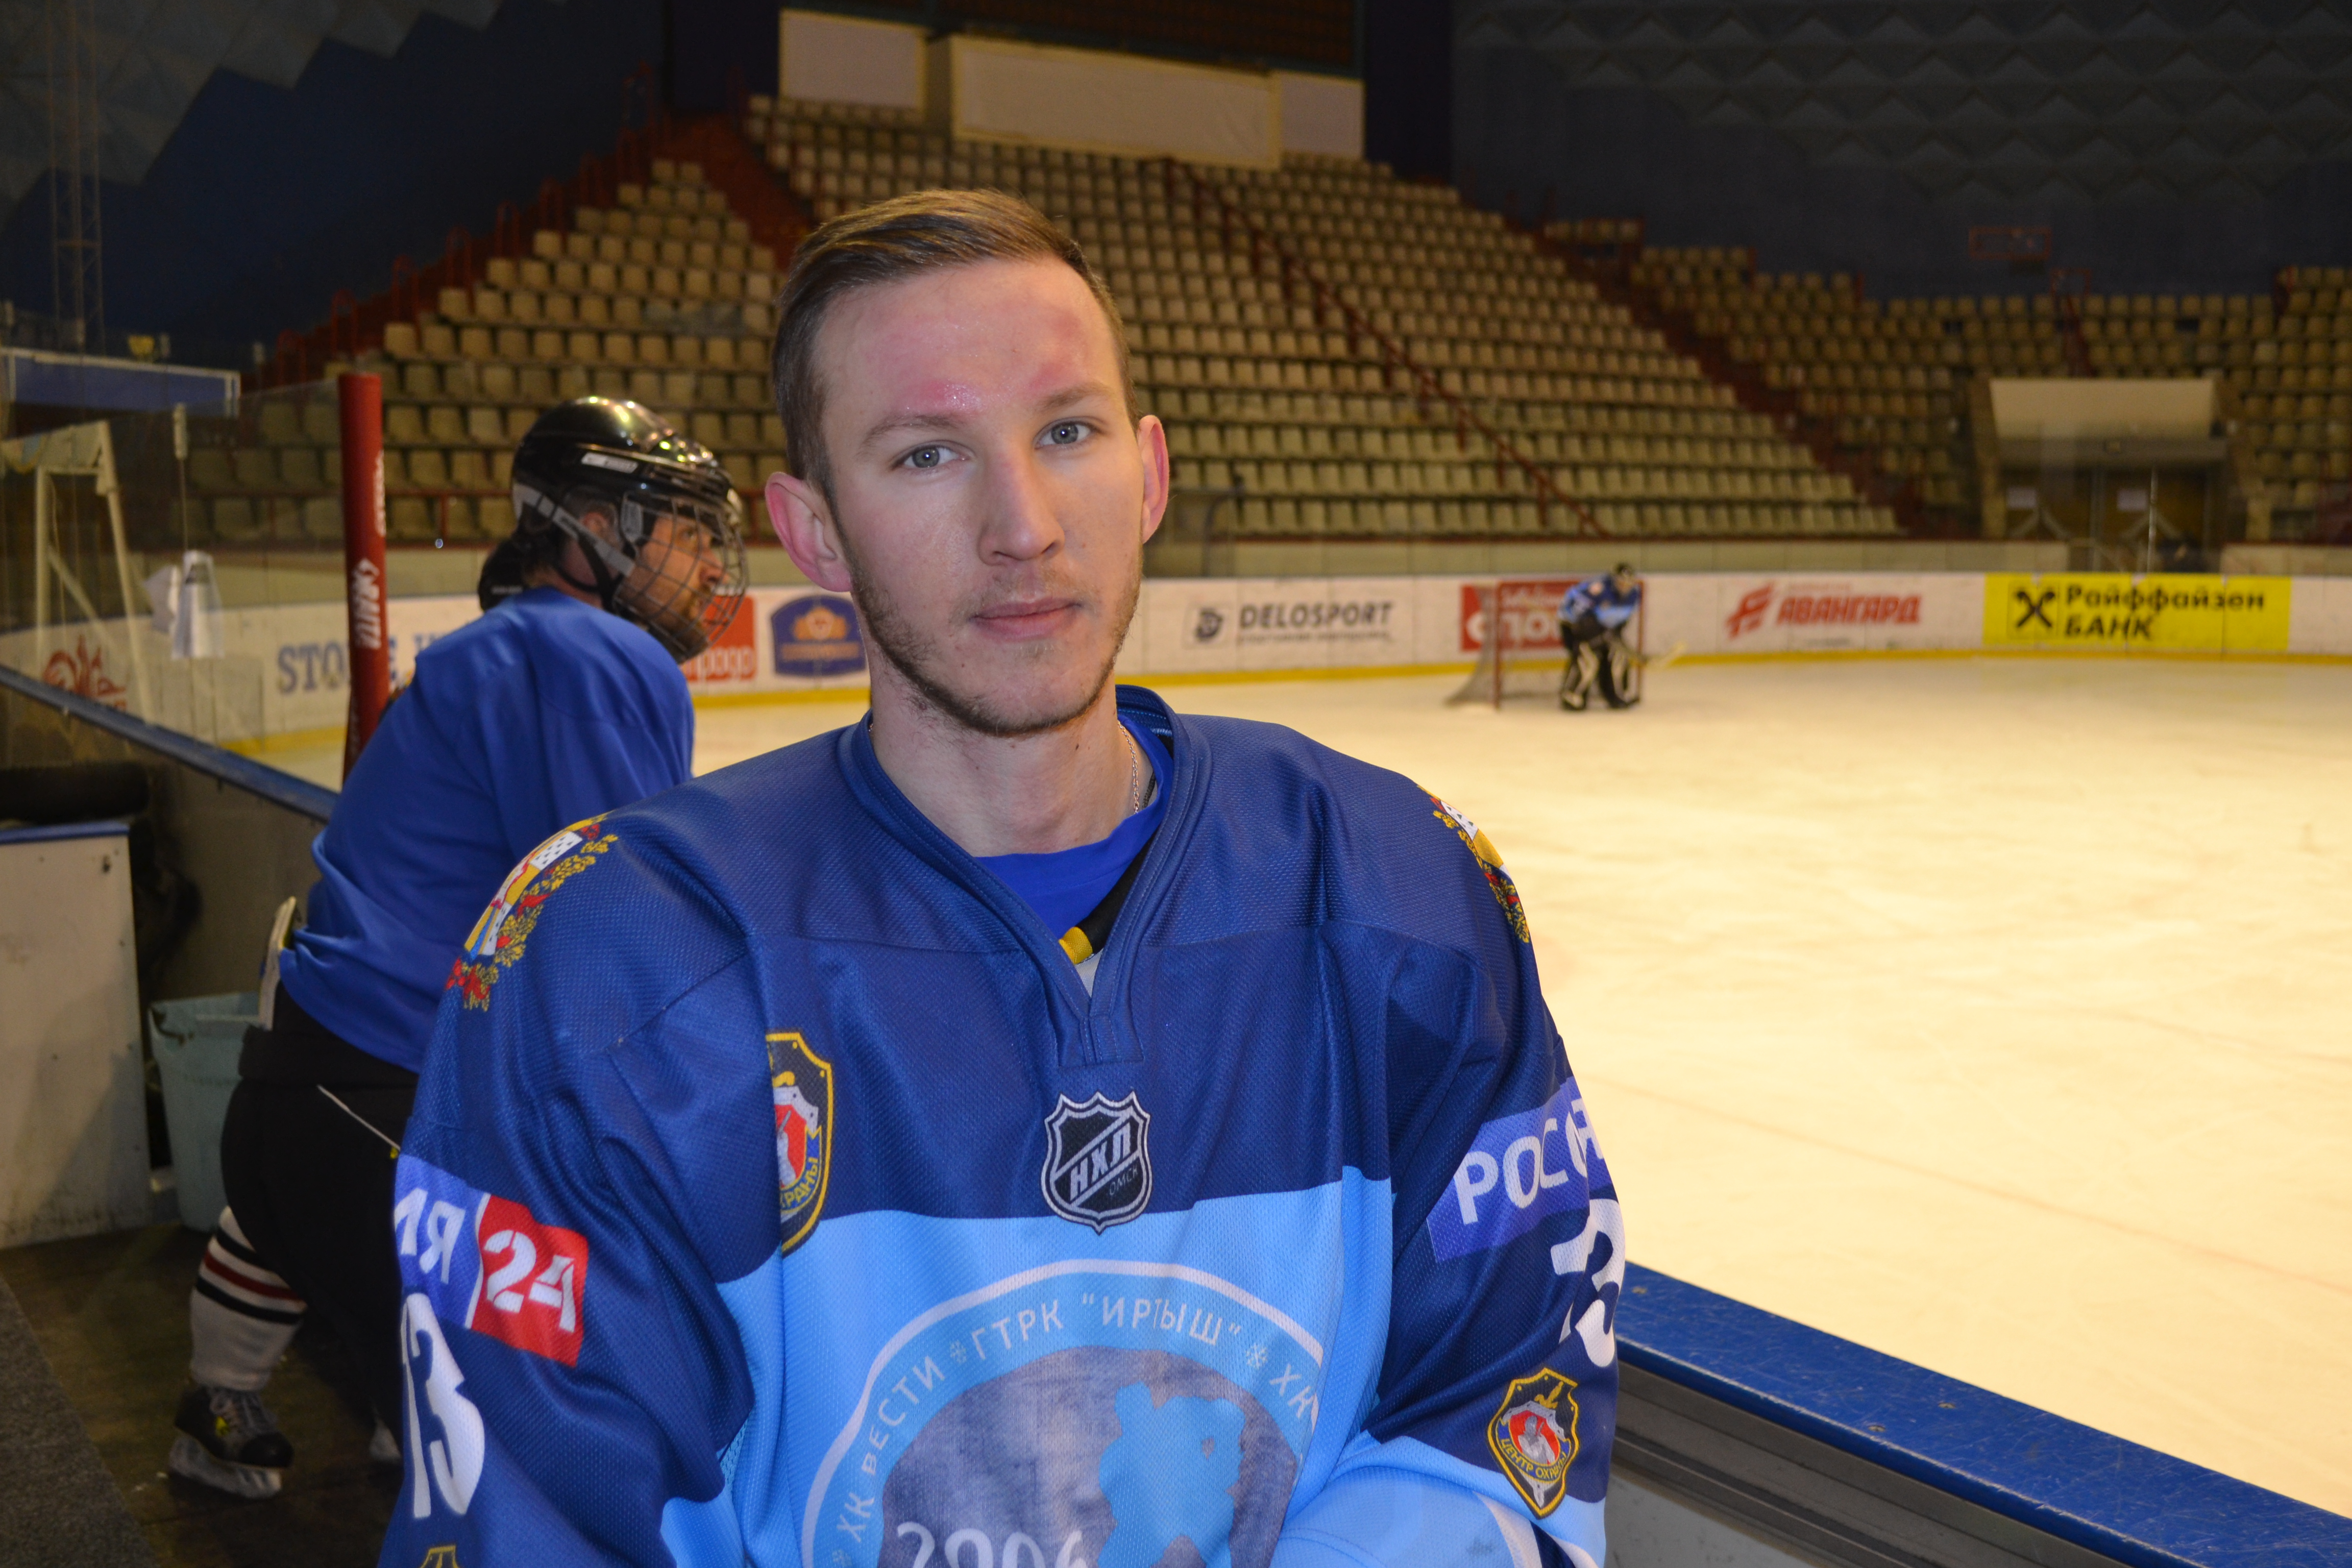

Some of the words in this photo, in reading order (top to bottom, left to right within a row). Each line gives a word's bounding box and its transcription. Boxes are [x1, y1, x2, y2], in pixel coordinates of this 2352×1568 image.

[1777, 595, 1921, 624] АВАНГАРД
[2066, 584, 2265, 612] Райффайзен
[1240, 602, 1393, 629] DELOSPORT
[2065, 614, 2153, 640] БАНК
[1070, 1122, 1131, 1201] НХЛ
[1109, 1167, 1138, 1195] ОМСК
[484, 1230, 576, 1333] 24
[836, 1491, 875, 1543] ХК
[861, 1355, 945, 1476] ВЕСТИ
[971, 1300, 1063, 1360] ГТРК
[1269, 1361, 1315, 1418] ХК
[1501, 1438, 1534, 1472] ЦЕНТР
